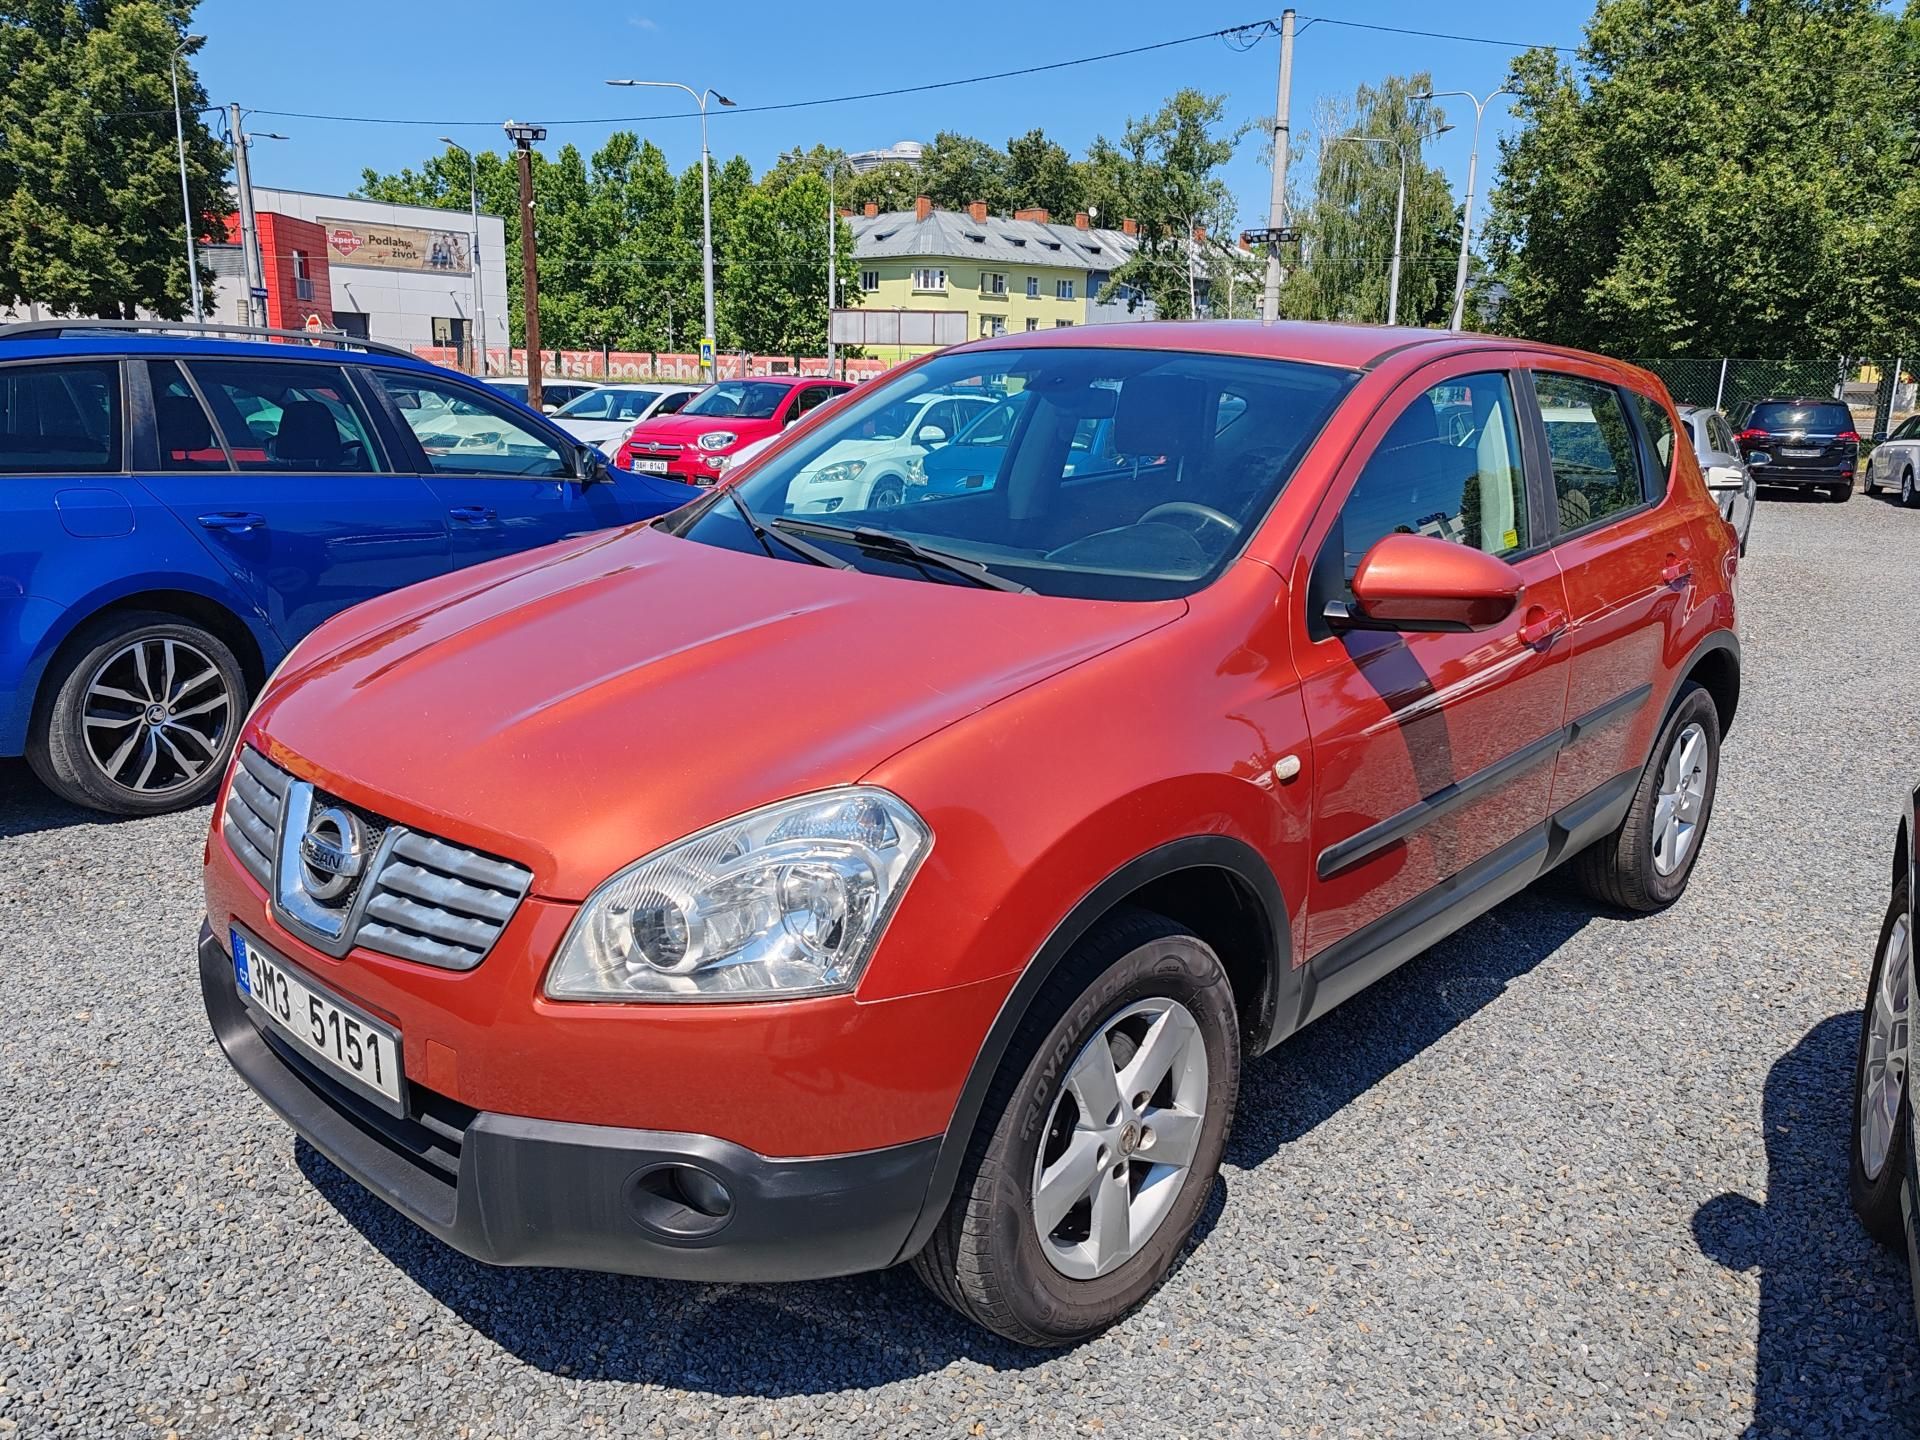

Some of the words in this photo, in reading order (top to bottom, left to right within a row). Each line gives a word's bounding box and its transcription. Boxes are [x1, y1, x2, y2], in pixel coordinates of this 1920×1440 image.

[328, 235, 361, 245] Experto
[486, 352, 593, 378] Nejětší
[649, 462, 665, 471] 8140
[239, 967, 249, 985] CZ
[250, 951, 291, 1022] 3M3
[308, 994, 383, 1086] 5151
